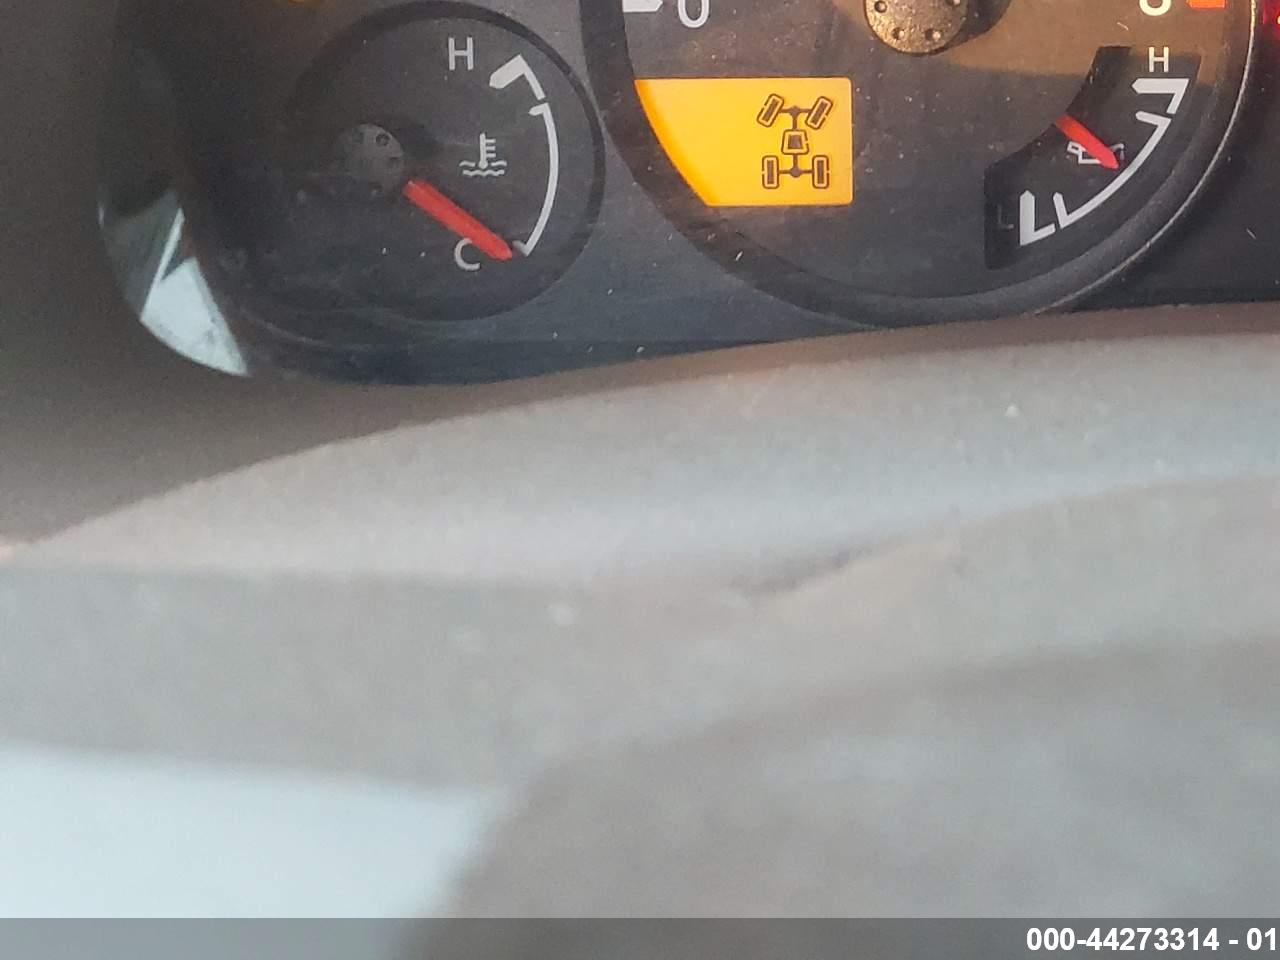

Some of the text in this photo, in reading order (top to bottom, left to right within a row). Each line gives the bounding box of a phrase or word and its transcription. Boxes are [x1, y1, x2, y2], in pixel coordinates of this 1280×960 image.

[449, 37, 474, 70] H
[1149, 47, 1169, 72] H
[454, 239, 481, 271] C
